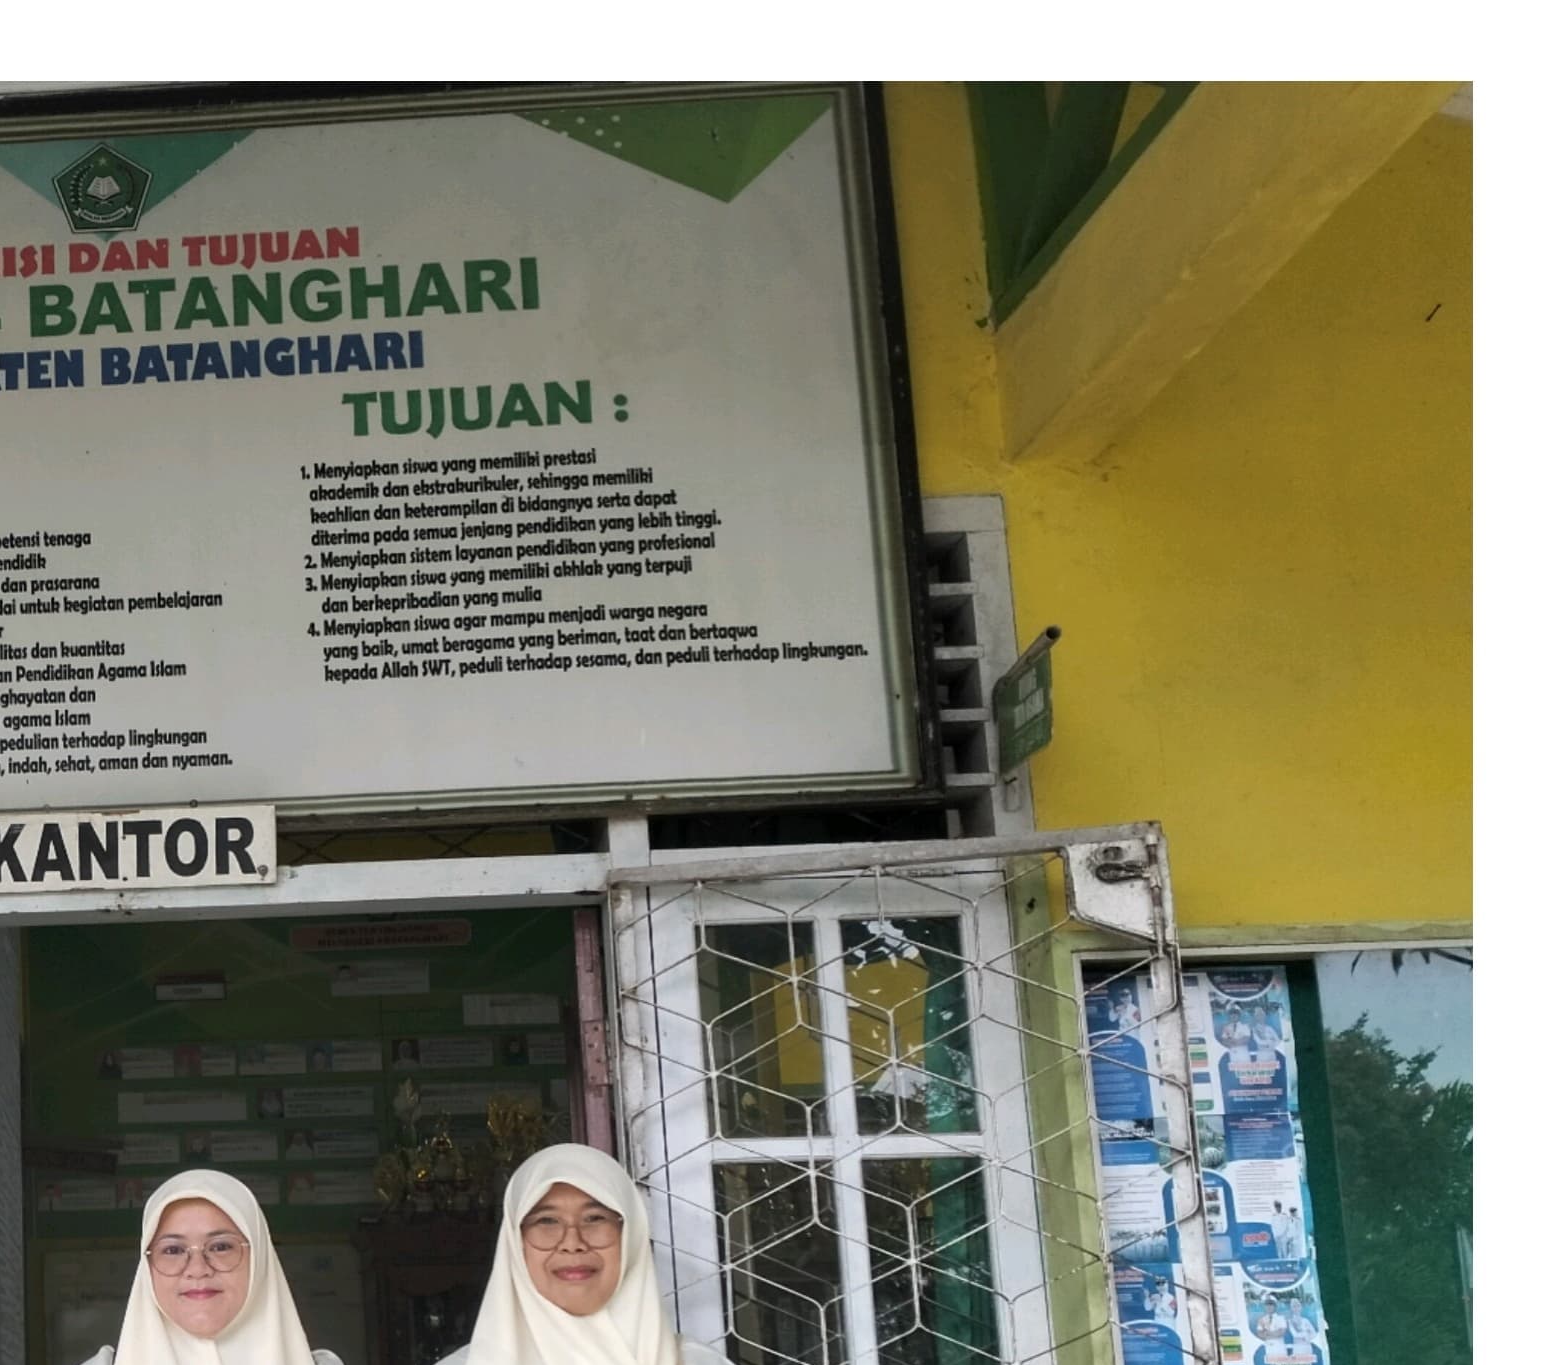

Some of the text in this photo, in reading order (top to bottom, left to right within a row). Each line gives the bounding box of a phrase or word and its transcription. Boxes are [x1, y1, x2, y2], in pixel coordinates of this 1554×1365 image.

[69, 238, 169, 273] DAN
[182, 226, 360, 270] TUJUAN
[29, 257, 541, 338] BATANGHARI
[100, 330, 425, 386] BATANGHARI
[342, 380, 593, 439] TUJUAN
[299, 447, 597, 481] 1. Menyiapkan siswa yang memiliki prestasi
[323, 641, 869, 685] kepada Allah SWT, peduli terhadap sesama, dan peduli terhadap lingkungan.
[61, 730, 126, 750] terhadap
[128, 728, 207, 749] lingkungan
[7, 755, 52, 775] indah,
[54, 754, 96, 774] sehat,
[98, 756, 139, 771] aman
[141, 751, 169, 769] dan
[171, 752, 233, 771] nyaman.
